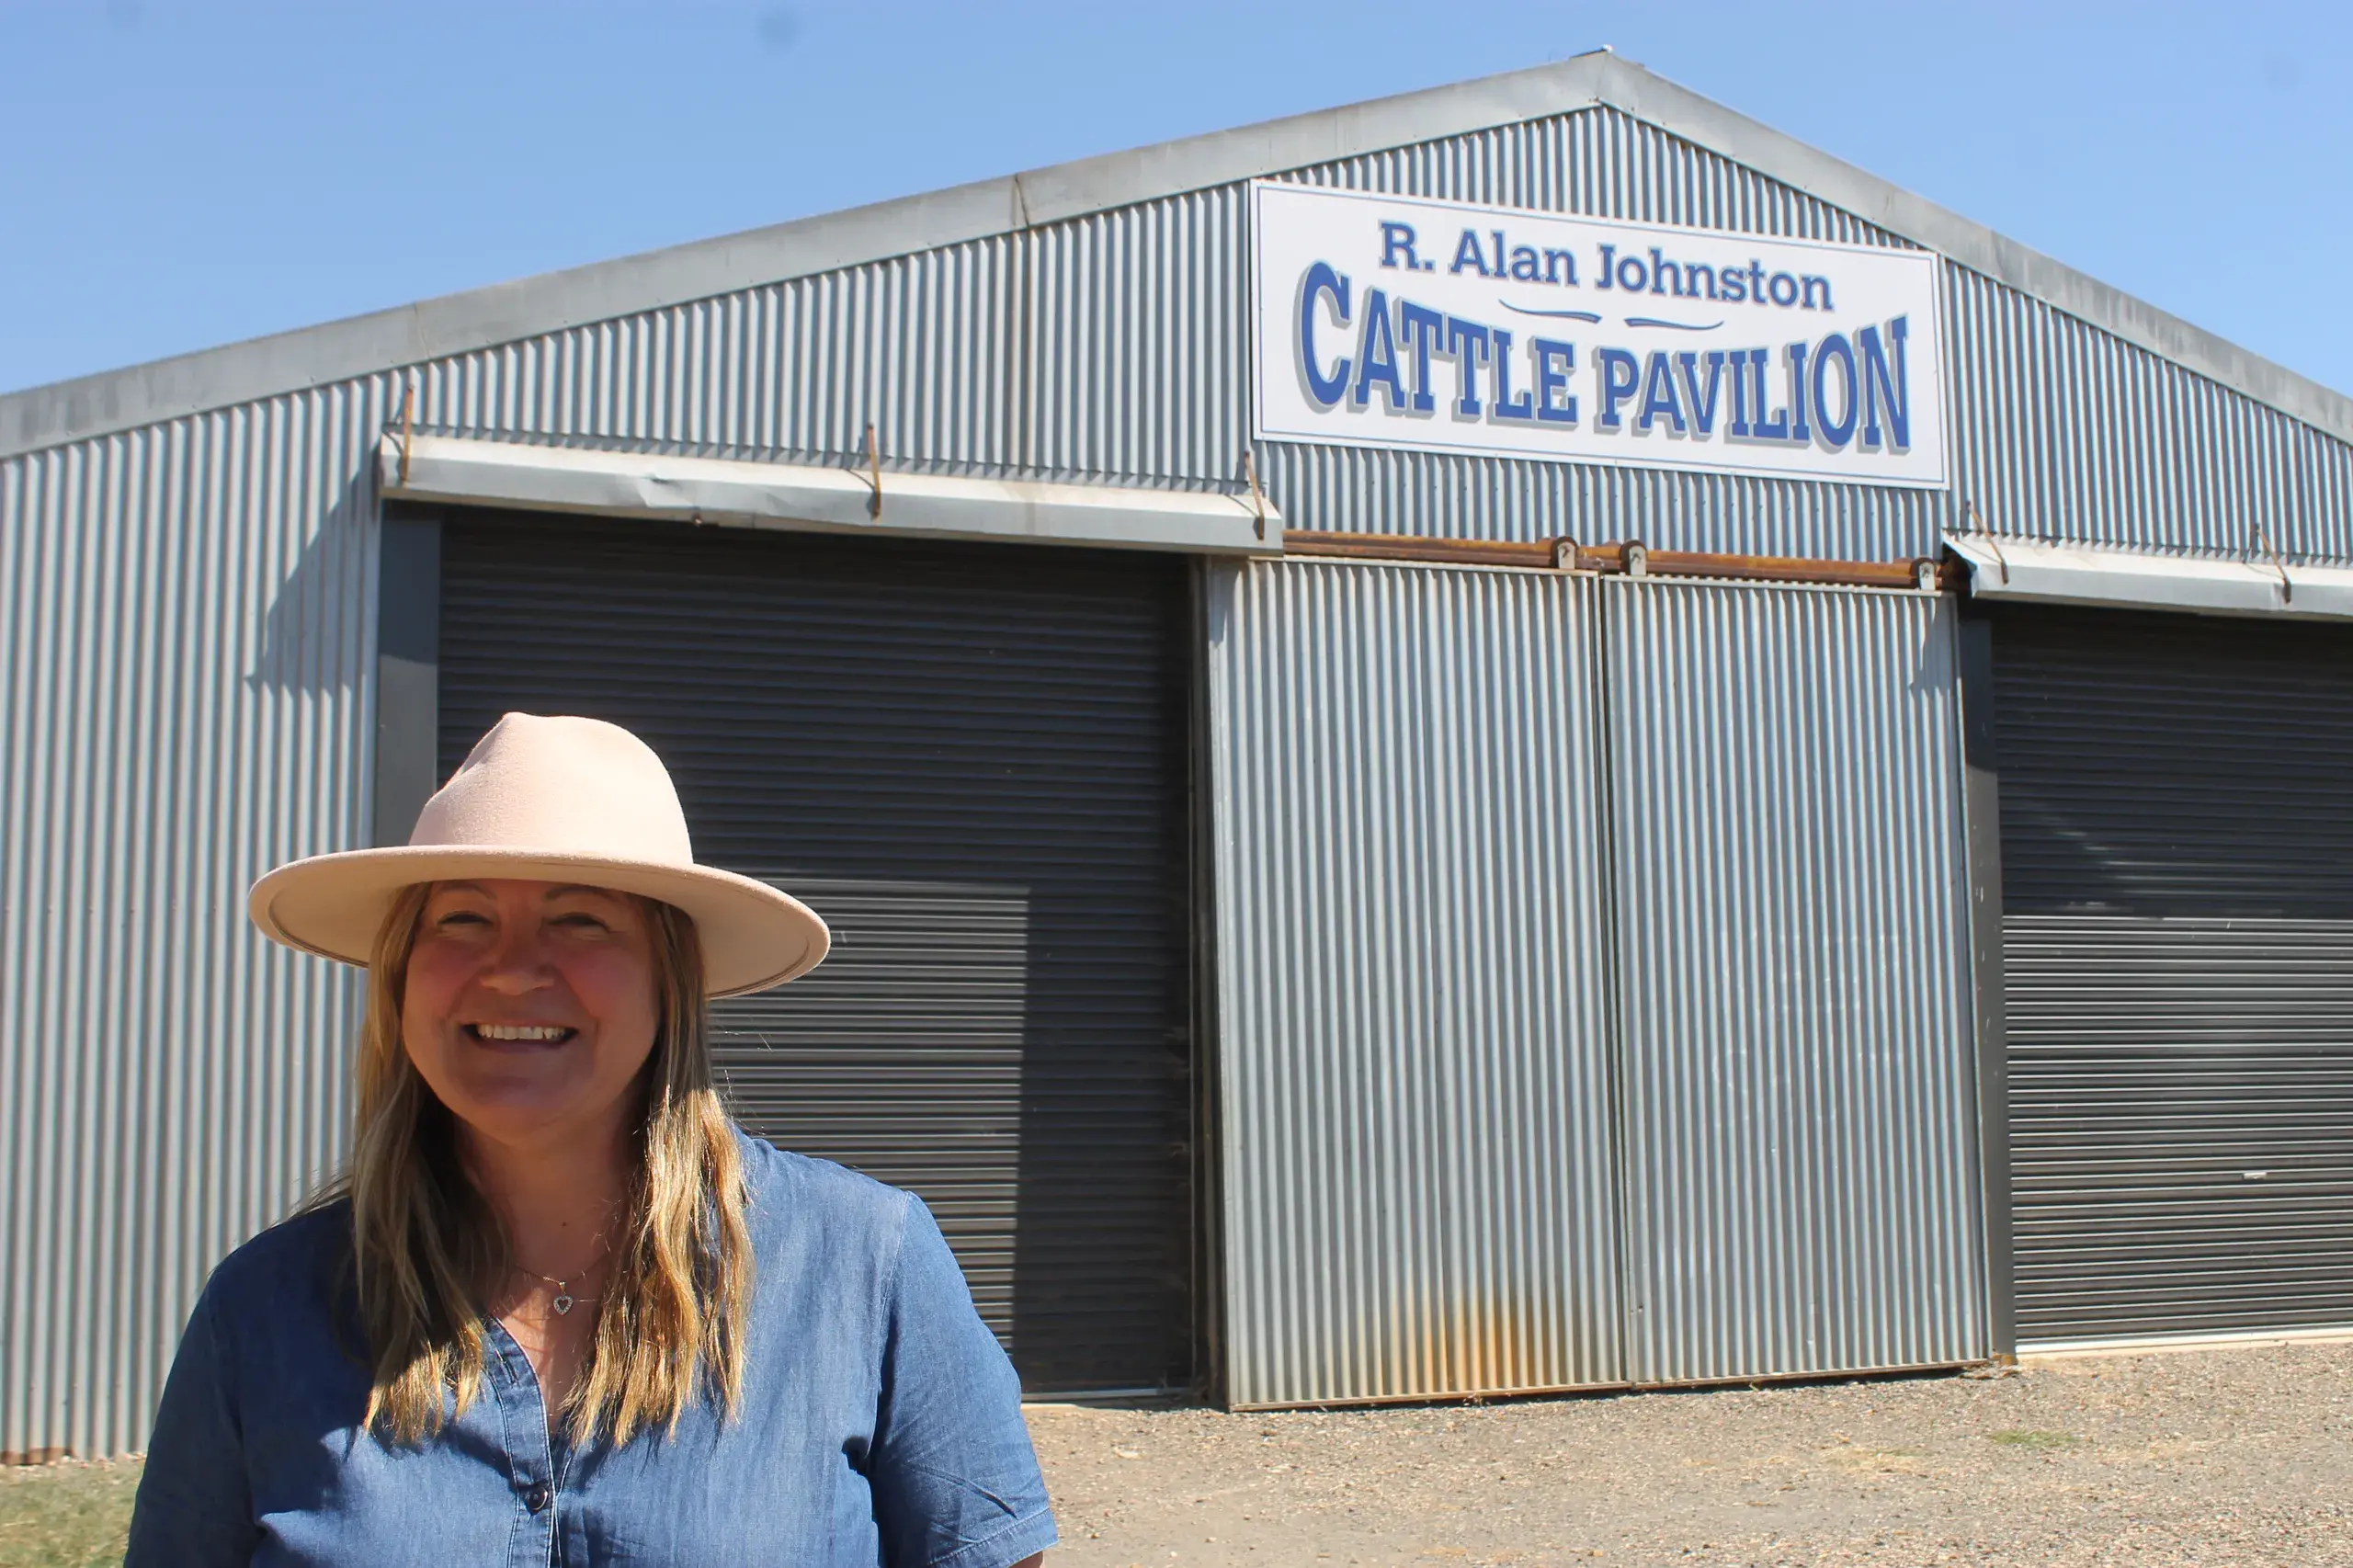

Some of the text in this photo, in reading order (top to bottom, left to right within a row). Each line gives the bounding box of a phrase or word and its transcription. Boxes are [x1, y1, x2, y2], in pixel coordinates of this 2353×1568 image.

[1380, 221, 1835, 311] R. Alan Johnston
[1296, 261, 1912, 450] CATTLE PAVILION
